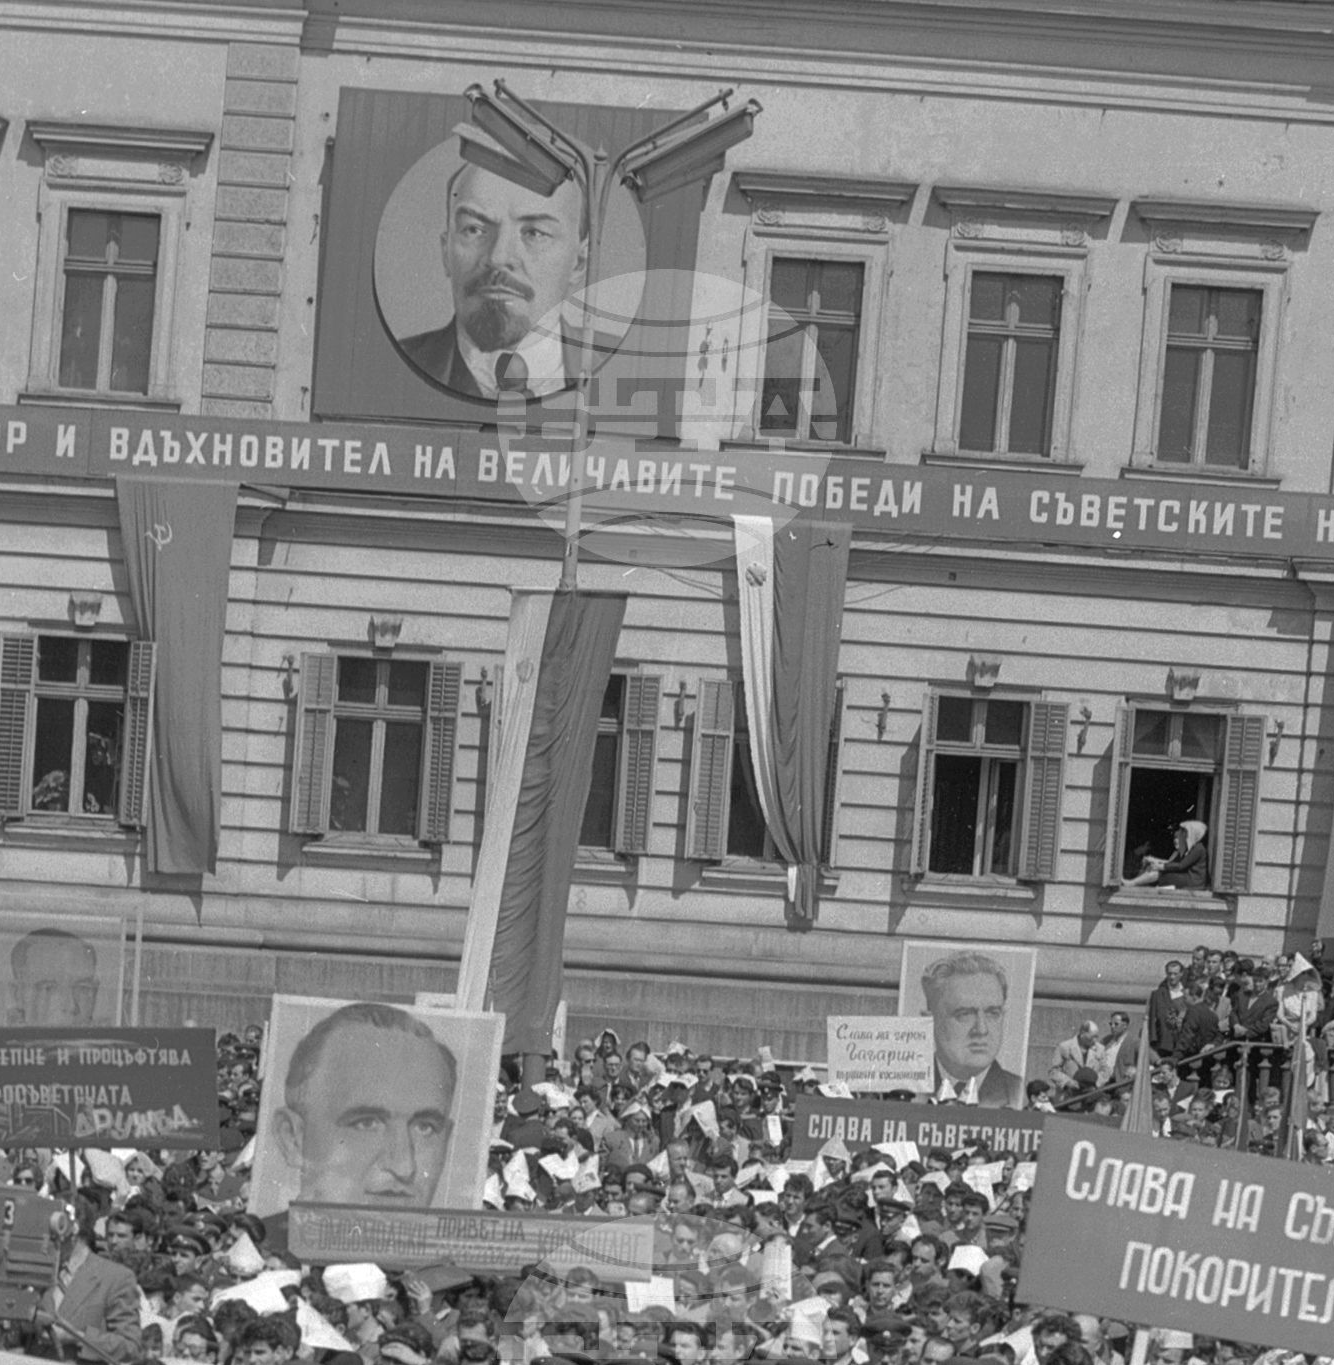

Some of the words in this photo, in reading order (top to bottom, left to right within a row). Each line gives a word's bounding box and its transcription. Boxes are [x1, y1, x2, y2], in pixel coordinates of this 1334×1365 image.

[56, 425, 75, 458] И
[110, 427, 391, 475] ВДЪХНОВИТЕЛ
[415, 446, 455, 480] НА
[478, 448, 737, 500] ВЕЛИЧАВИТЕ
[772, 471, 923, 518] ПОБЕДИ
[952, 486, 1000, 520] НА
[1030, 490, 1285, 539] СЪВЕТСКИТЕ
[58, 1049, 70, 1066] И
[79, 1048, 192, 1067] ПРОЦЪФТЯВА
[808, 1114, 872, 1142] СЛАВА
[882, 1120, 908, 1143] НА
[918, 1122, 1043, 1152] СЪВЕТСКИТЕ
[1067, 1140, 1195, 1219] СЛАВА
[1213, 1179, 1264, 1232] НА
[4, 1200, 15, 1225] 3
